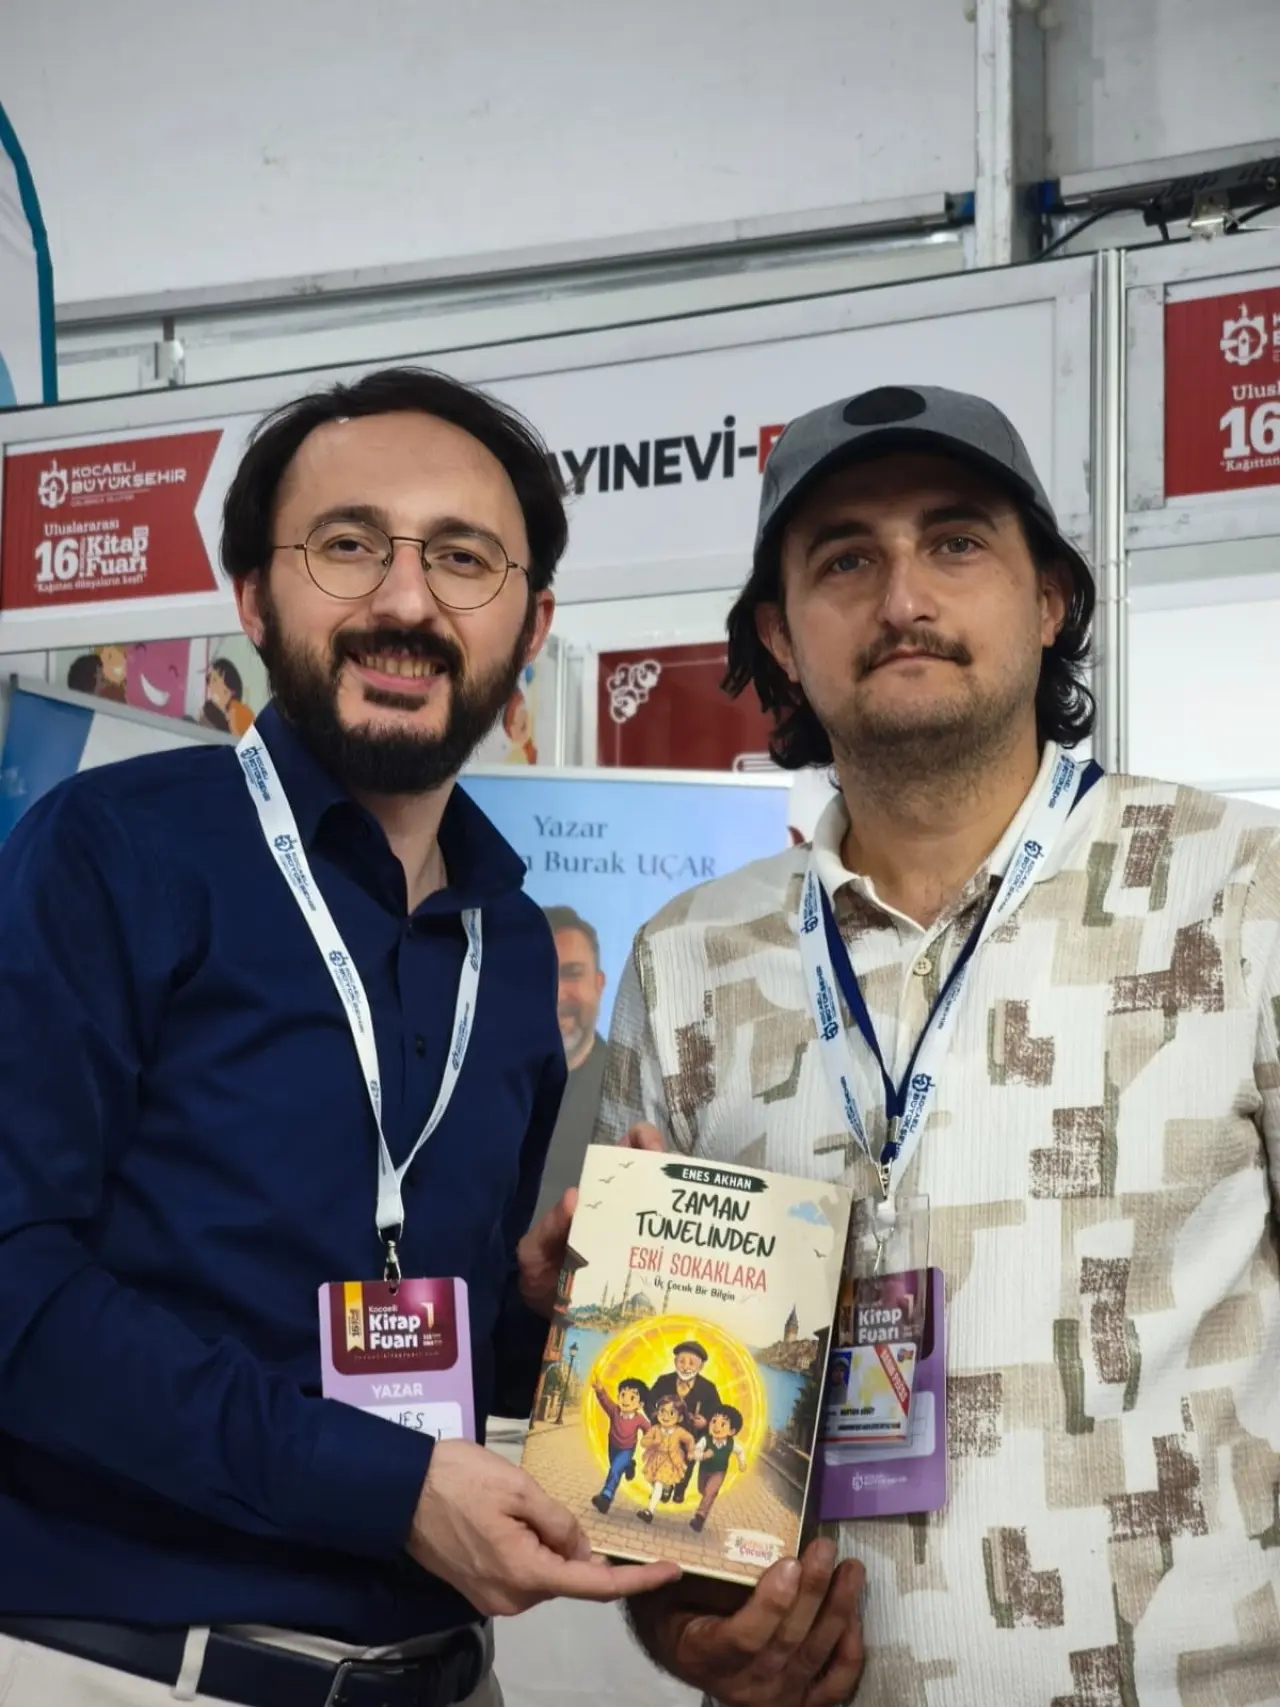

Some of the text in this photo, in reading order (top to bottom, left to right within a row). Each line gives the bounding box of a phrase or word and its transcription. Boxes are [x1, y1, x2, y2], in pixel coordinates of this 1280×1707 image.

[44, 519, 119, 536] Uluslararası
[87, 530, 149, 559] Kitap
[86, 554, 148, 578] Fuarı
[533, 815, 608, 840] Yazar
[544, 851, 626, 875] Burak
[637, 853, 716, 881] UÇAR
[682, 1168, 752, 1190] ENES AKHAN
[671, 1188, 750, 1222] ZAMAN
[628, 1246, 767, 1293] ESKİ SOKAKLARA
[695, 1284, 708, 1296] Bir
[710, 1287, 736, 1301] Bilgin
[368, 1313, 421, 1332] Kitap
[858, 1307, 903, 1327] Kitap
[370, 1332, 418, 1350] Fuarı
[858, 1326, 899, 1345] Fuarı
[371, 1383, 424, 1399] YAZAR
